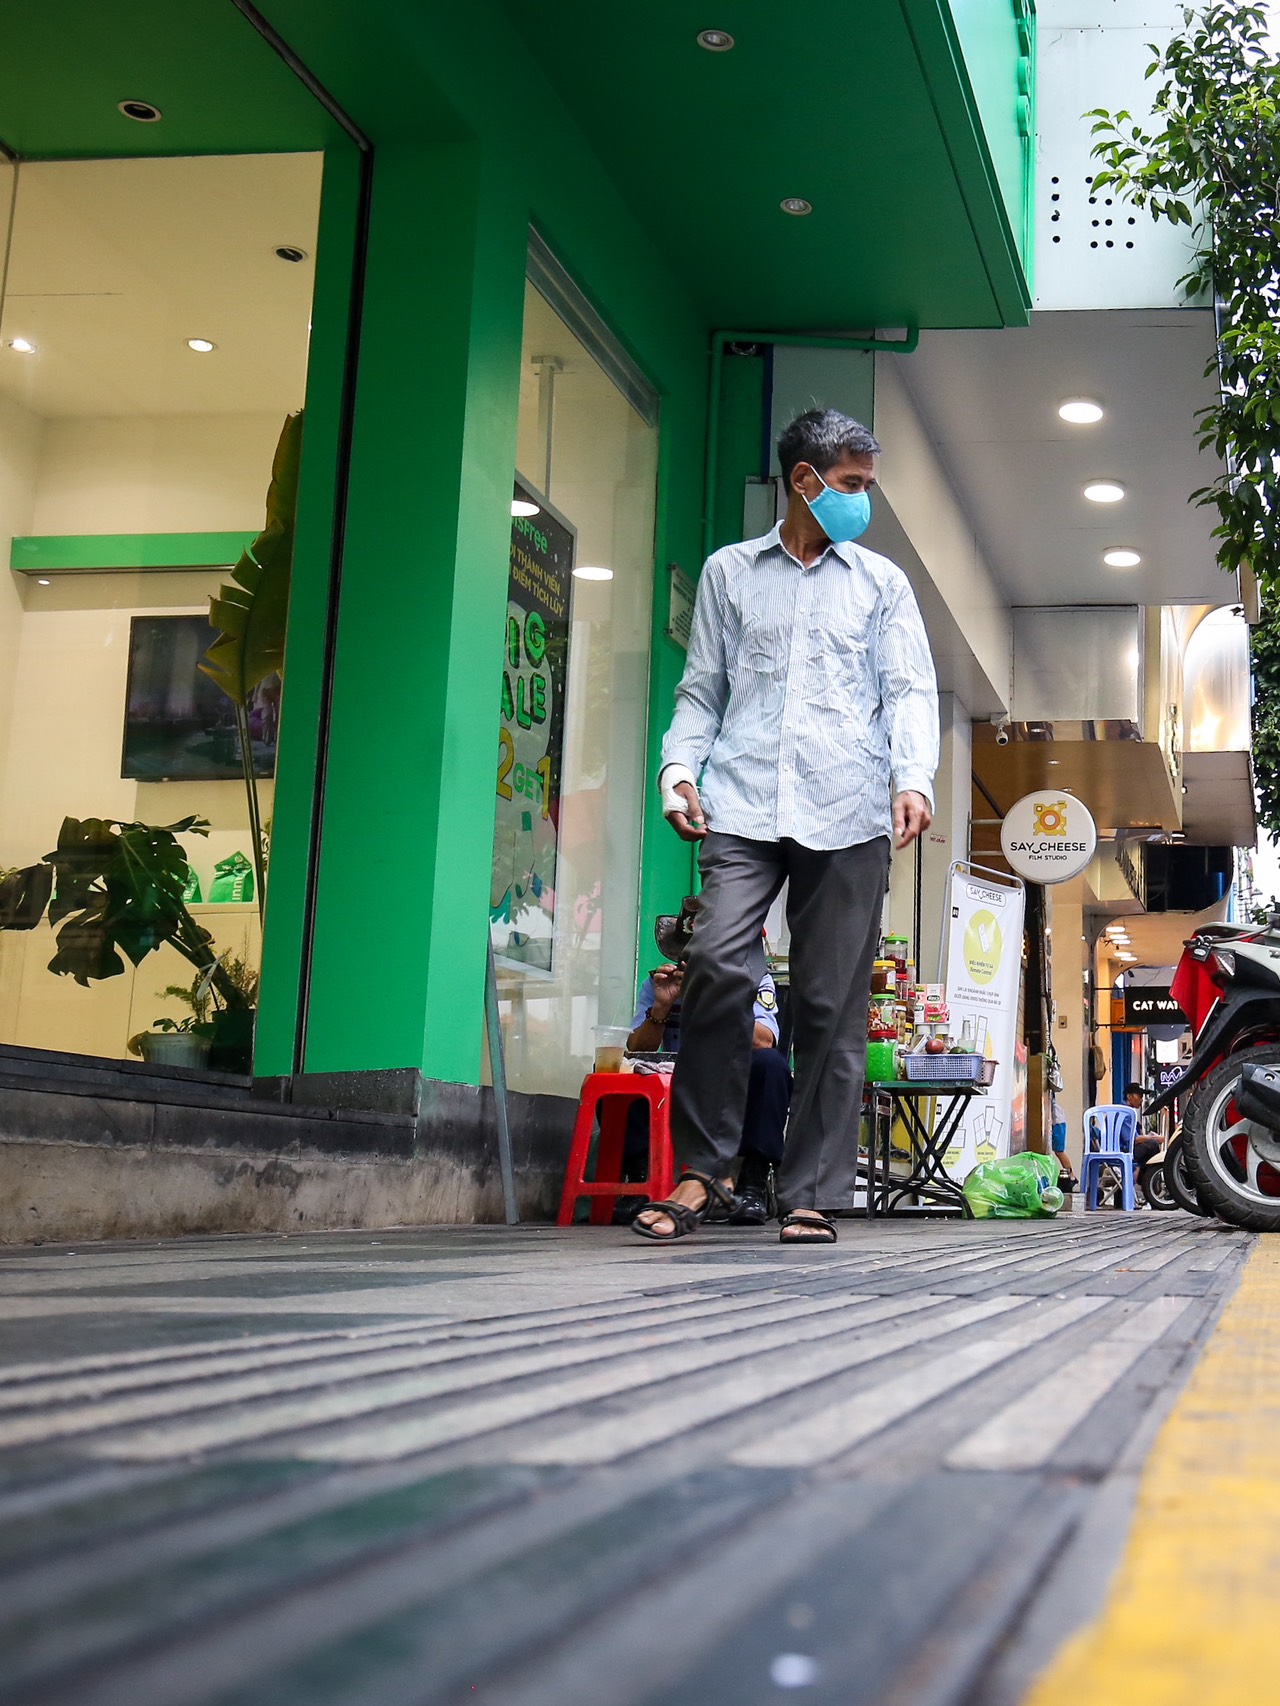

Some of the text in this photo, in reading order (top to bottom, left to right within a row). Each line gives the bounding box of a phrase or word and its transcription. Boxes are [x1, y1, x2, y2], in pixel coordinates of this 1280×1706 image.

[512, 763, 544, 803] GET
[537, 754, 550, 821] 1
[1010, 842, 1086, 852] SAY CHEESE
[1132, 1000, 1154, 1010] CAT
